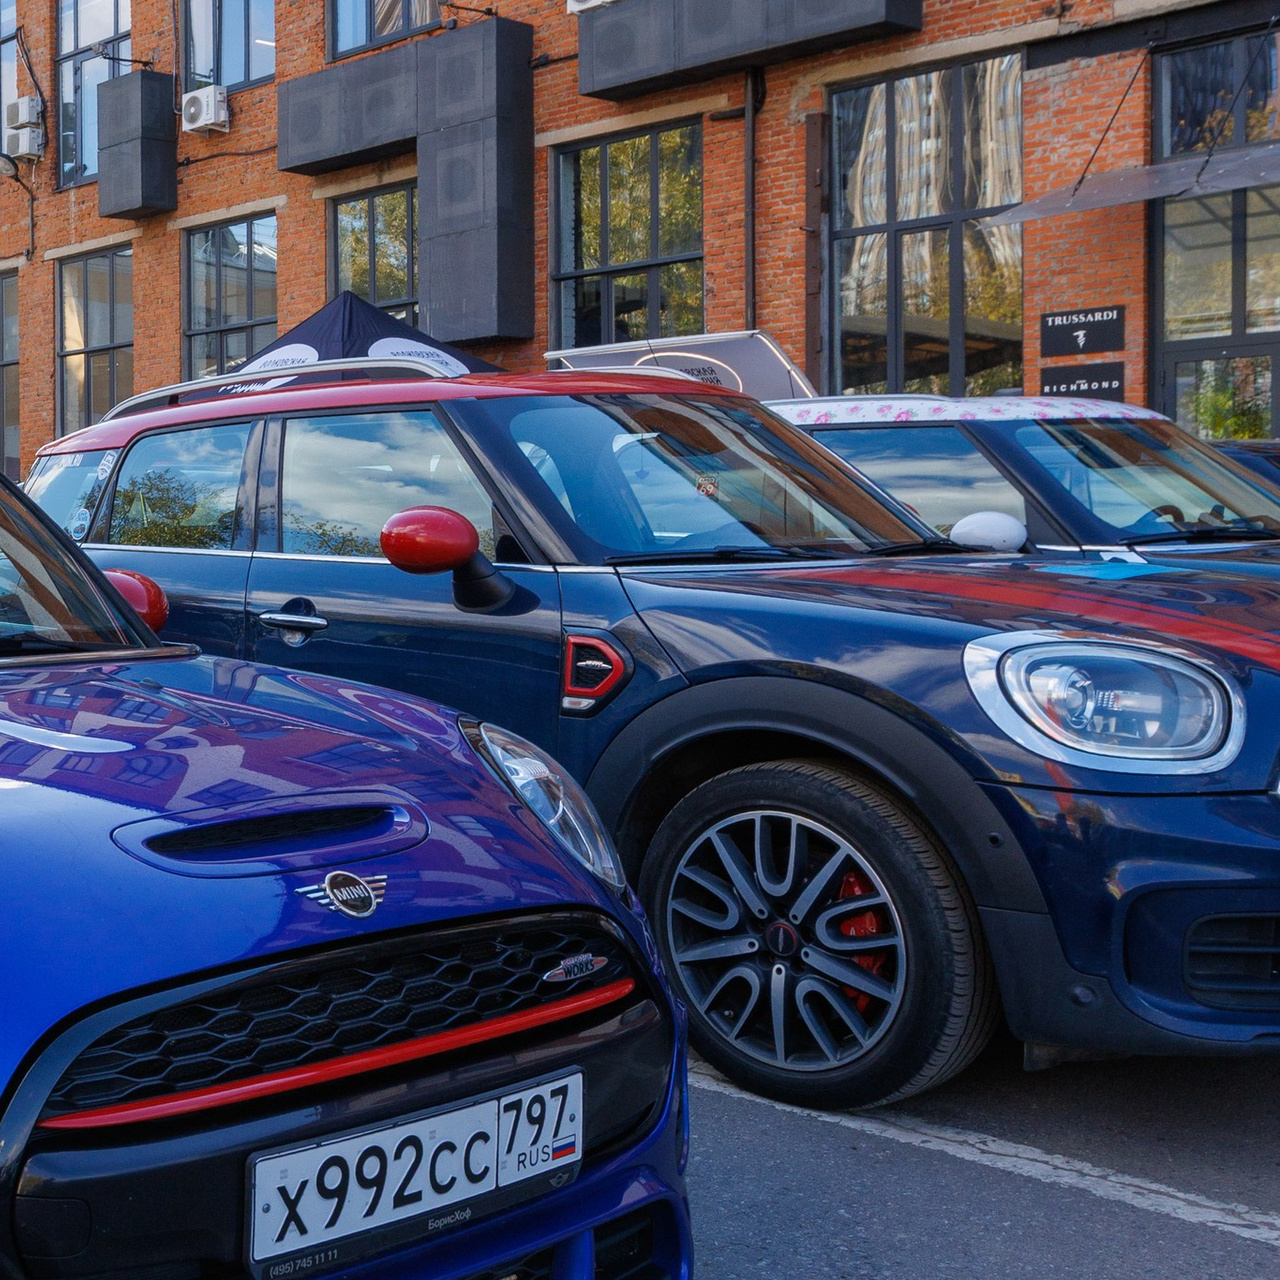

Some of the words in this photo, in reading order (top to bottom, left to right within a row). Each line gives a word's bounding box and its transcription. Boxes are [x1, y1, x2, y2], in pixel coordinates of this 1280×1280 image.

[1046, 310, 1118, 327] TRUSSARDI
[1043, 380, 1120, 394] RICHMOND
[333, 884, 369, 901] MINI
[563, 958, 595, 979] WORKS
[502, 1083, 569, 1155] 797
[517, 1145, 550, 1172] RUS
[428, 1208, 472, 1230] БорисХоф
[270, 1261, 294, 1278] (495)
[295, 1256, 312, 1270] 745
[314, 1252, 325, 1264] 11
[328, 1249, 338, 1260] 11
